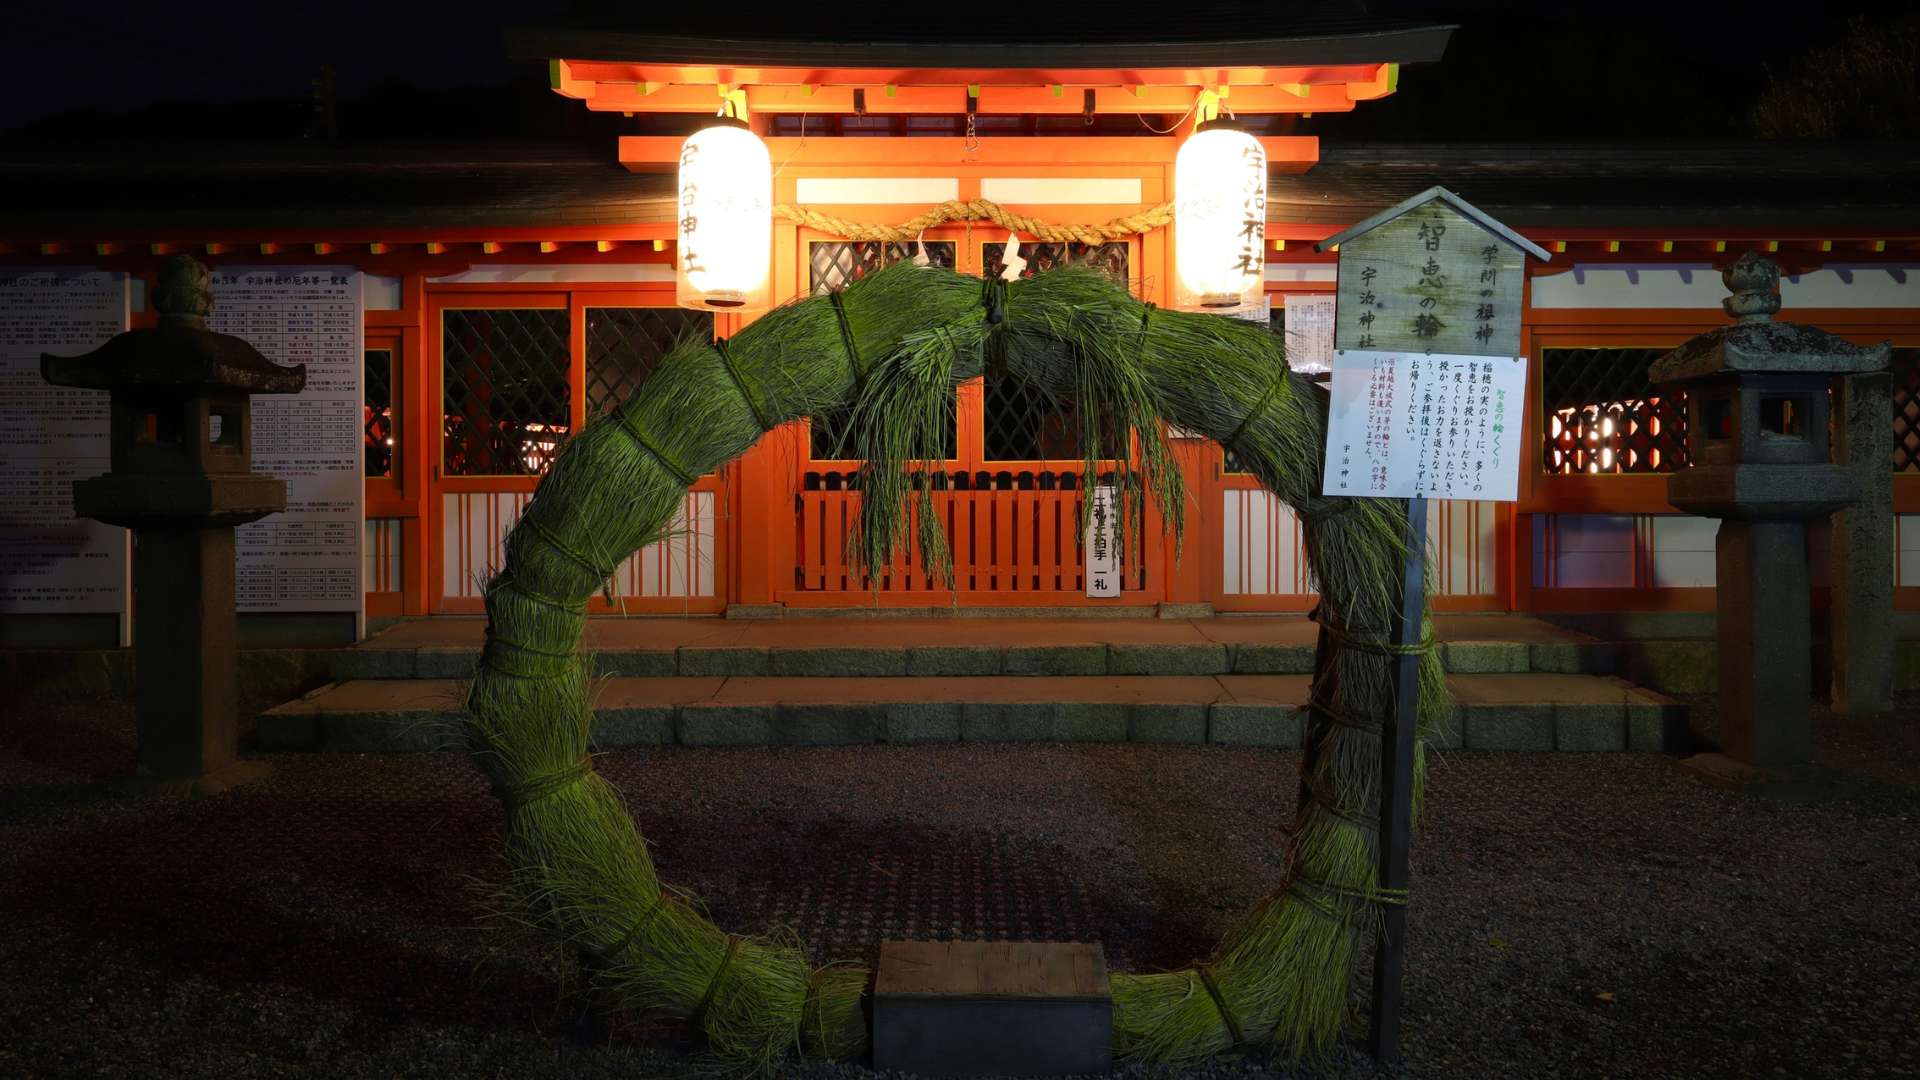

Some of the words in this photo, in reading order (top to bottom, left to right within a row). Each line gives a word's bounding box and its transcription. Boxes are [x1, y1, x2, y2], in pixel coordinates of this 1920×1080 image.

[1358, 266, 1377, 348] 宇治神社
[1411, 221, 1448, 338] 智恵の輪
[1475, 244, 1498, 344] 学問の祖神
[1406, 360, 1420, 441] お帰りください。
[1430, 360, 1450, 491] 授かったお力を返さないよ
[1459, 361, 1478, 486] 智恵をお授かりください。
[1473, 362, 1494, 492] 稲穂の実のように、多くの
